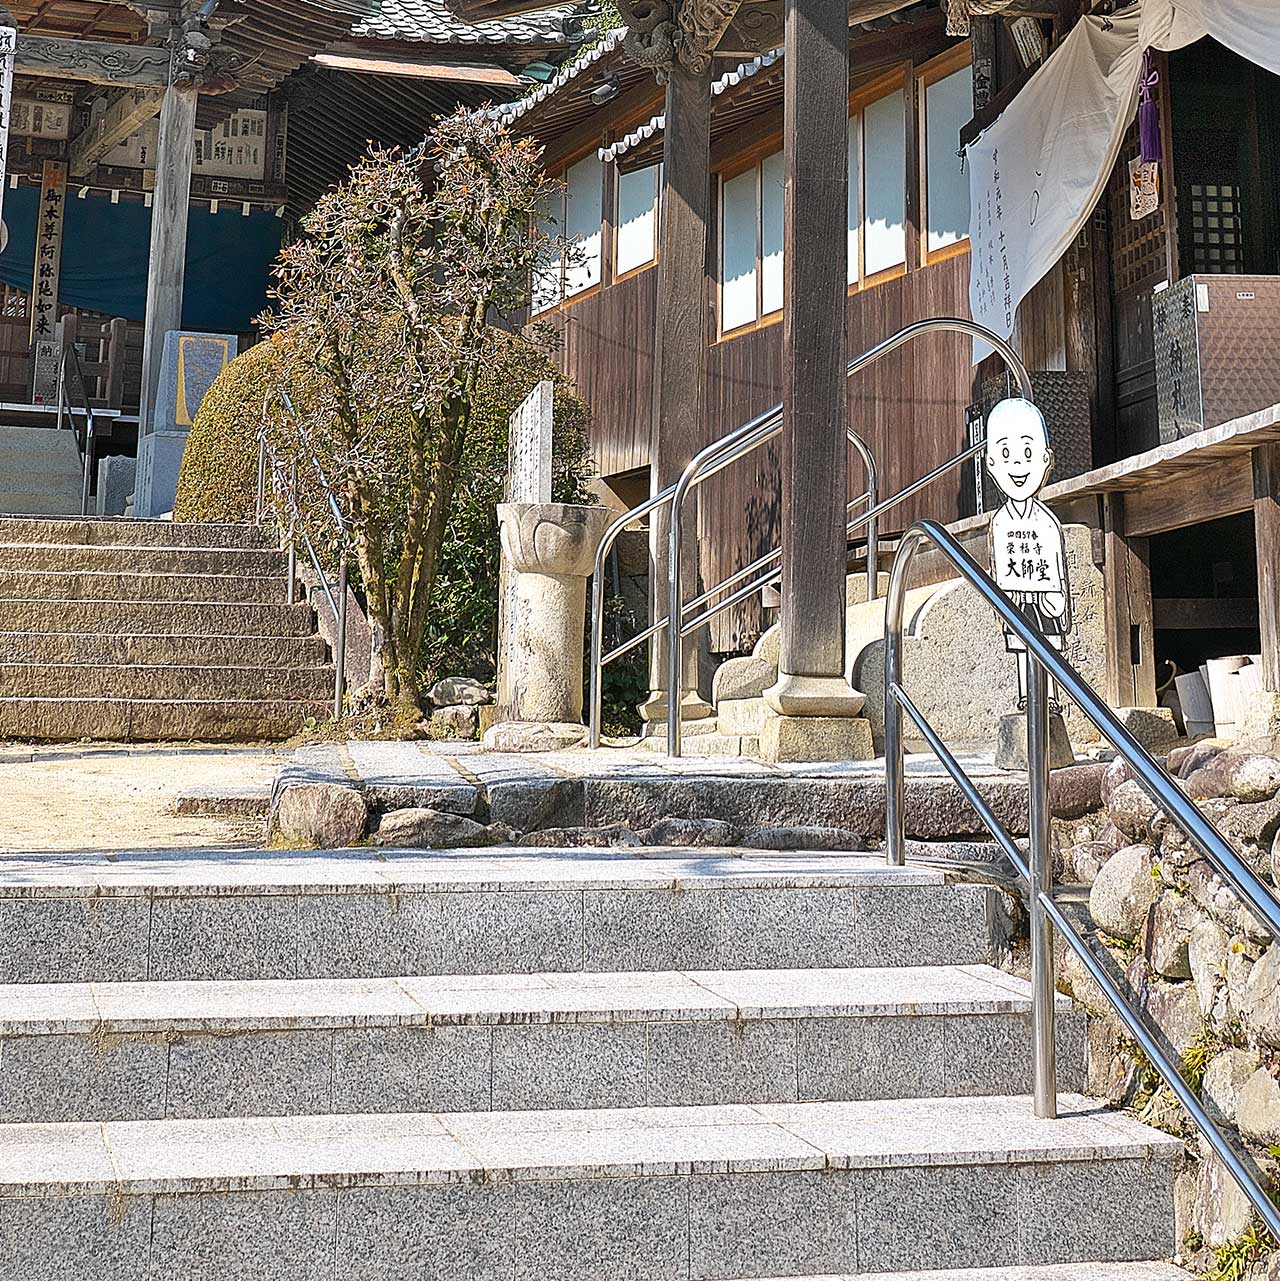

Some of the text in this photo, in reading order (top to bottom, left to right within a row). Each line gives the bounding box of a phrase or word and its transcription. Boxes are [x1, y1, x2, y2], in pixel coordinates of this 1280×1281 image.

[1006, 543, 1043, 555] 栄福寺
[1005, 558, 1051, 582] 大師堂
